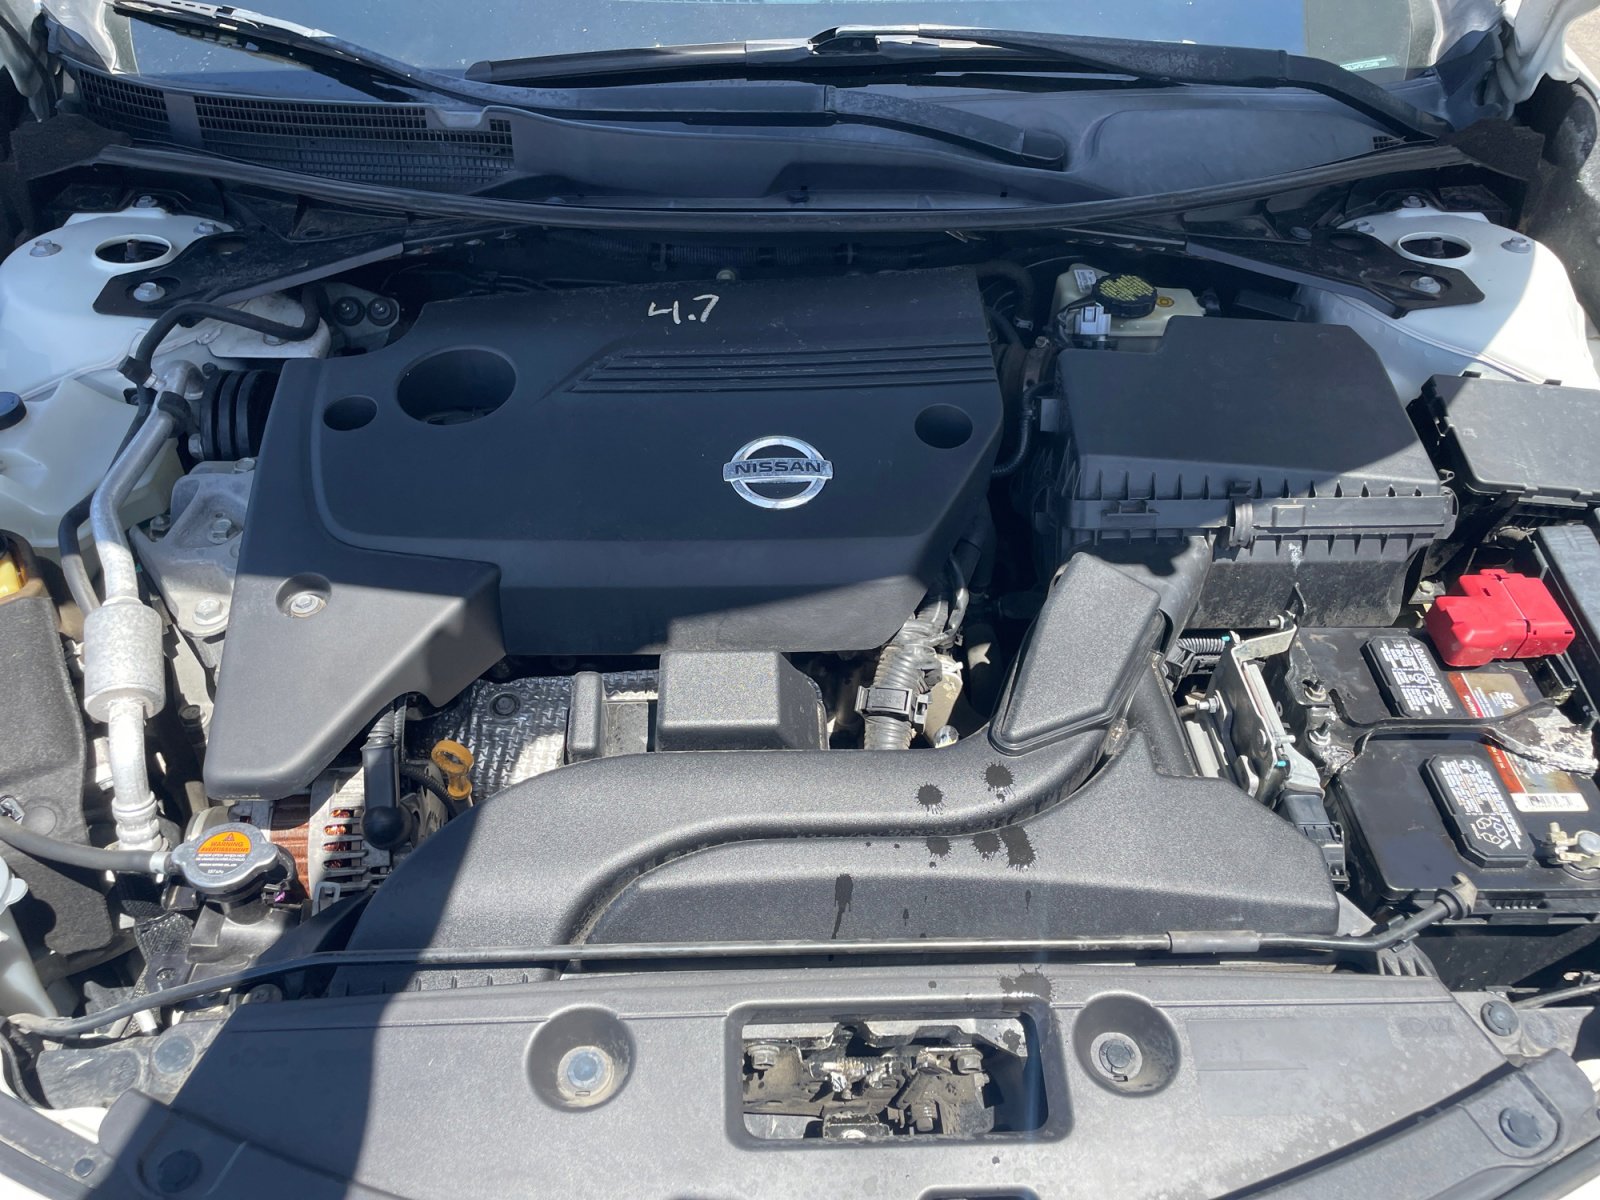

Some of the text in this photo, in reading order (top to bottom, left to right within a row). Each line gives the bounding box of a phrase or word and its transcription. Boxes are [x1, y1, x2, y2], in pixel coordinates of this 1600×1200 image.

[648, 294, 719, 324] 4.7
[735, 461, 821, 474] NISSAN
[1415, 648, 1436, 677] DANGER
[1432, 683, 1454, 709] POISON
